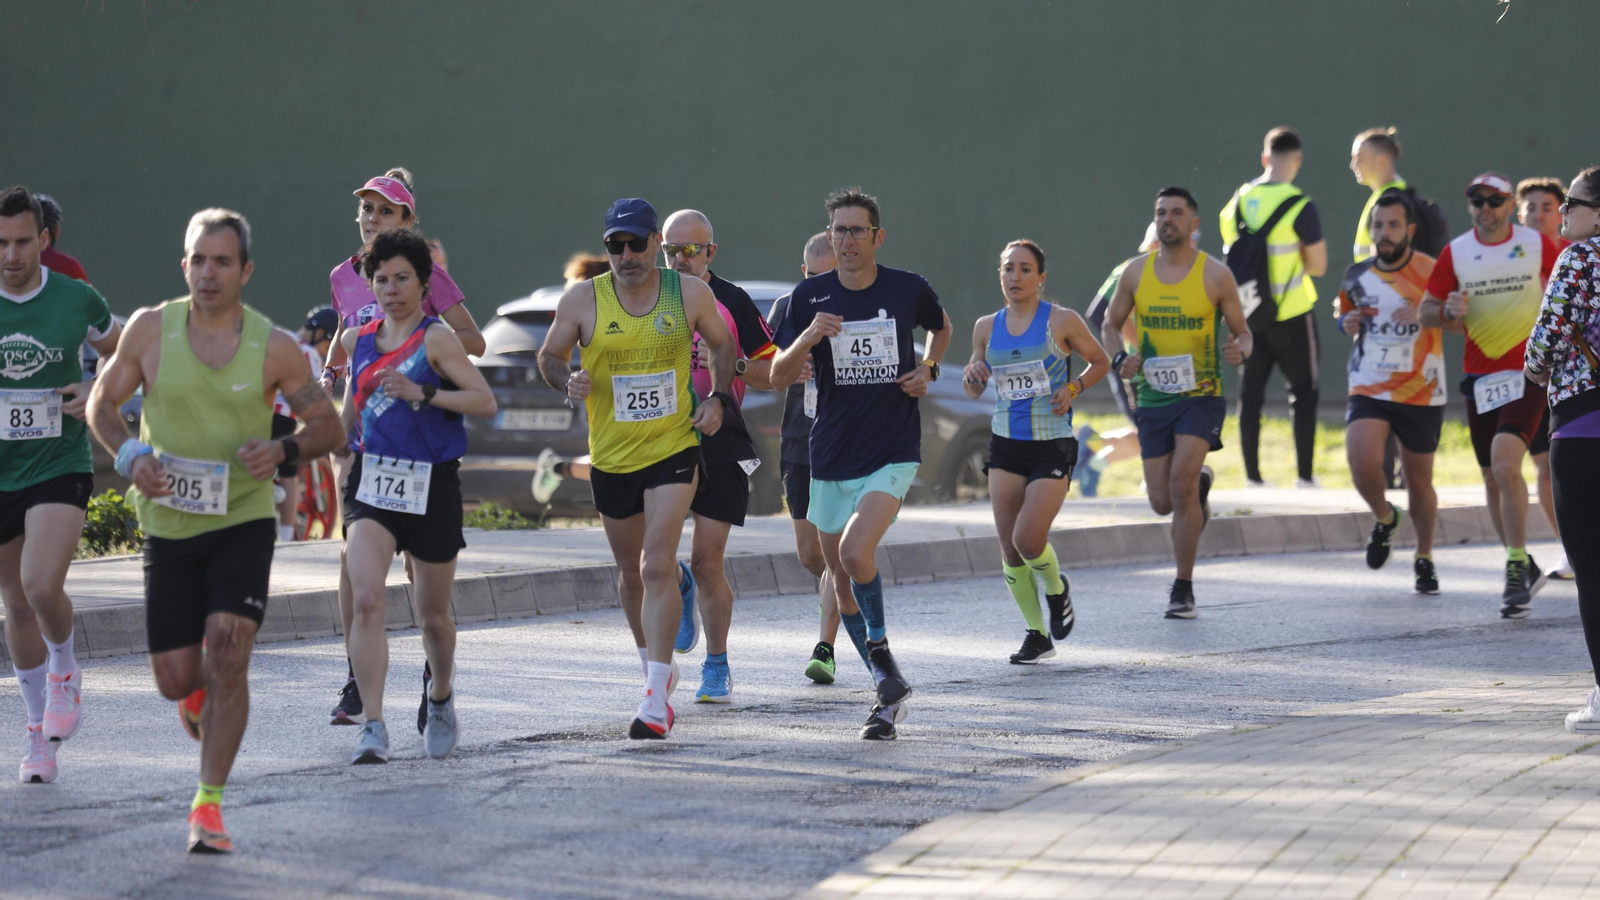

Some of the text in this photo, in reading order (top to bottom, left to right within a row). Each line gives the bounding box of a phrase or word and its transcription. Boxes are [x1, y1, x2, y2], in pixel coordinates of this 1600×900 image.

[1490, 275, 1532, 286] TRIATLÓN
[1474, 284, 1524, 296] ALGECIRAS
[2, 341, 33, 349] PIZZERÍA
[850, 338, 873, 357] 45
[607, 346, 677, 362] RUTEROS
[1381, 348, 1388, 362] 7
[851, 358, 882, 366] EVOS
[835, 378, 857, 386] CIUDAD
[867, 376, 897, 384] ALGECIRAS
[1007, 375, 1033, 390] 118
[1154, 370, 1178, 386] 130
[1011, 391, 1037, 399] EVOS
[1485, 384, 1510, 403] 213
[626, 390, 660, 411] 255
[10, 408, 34, 428] 83
[632, 411, 663, 420] EVOS
[8, 430, 43, 438] EVOS
[166, 474, 202, 500] 205
[374, 475, 406, 499] 174
[170, 501, 205, 512] EVOS
[374, 499, 407, 511] EVOS
